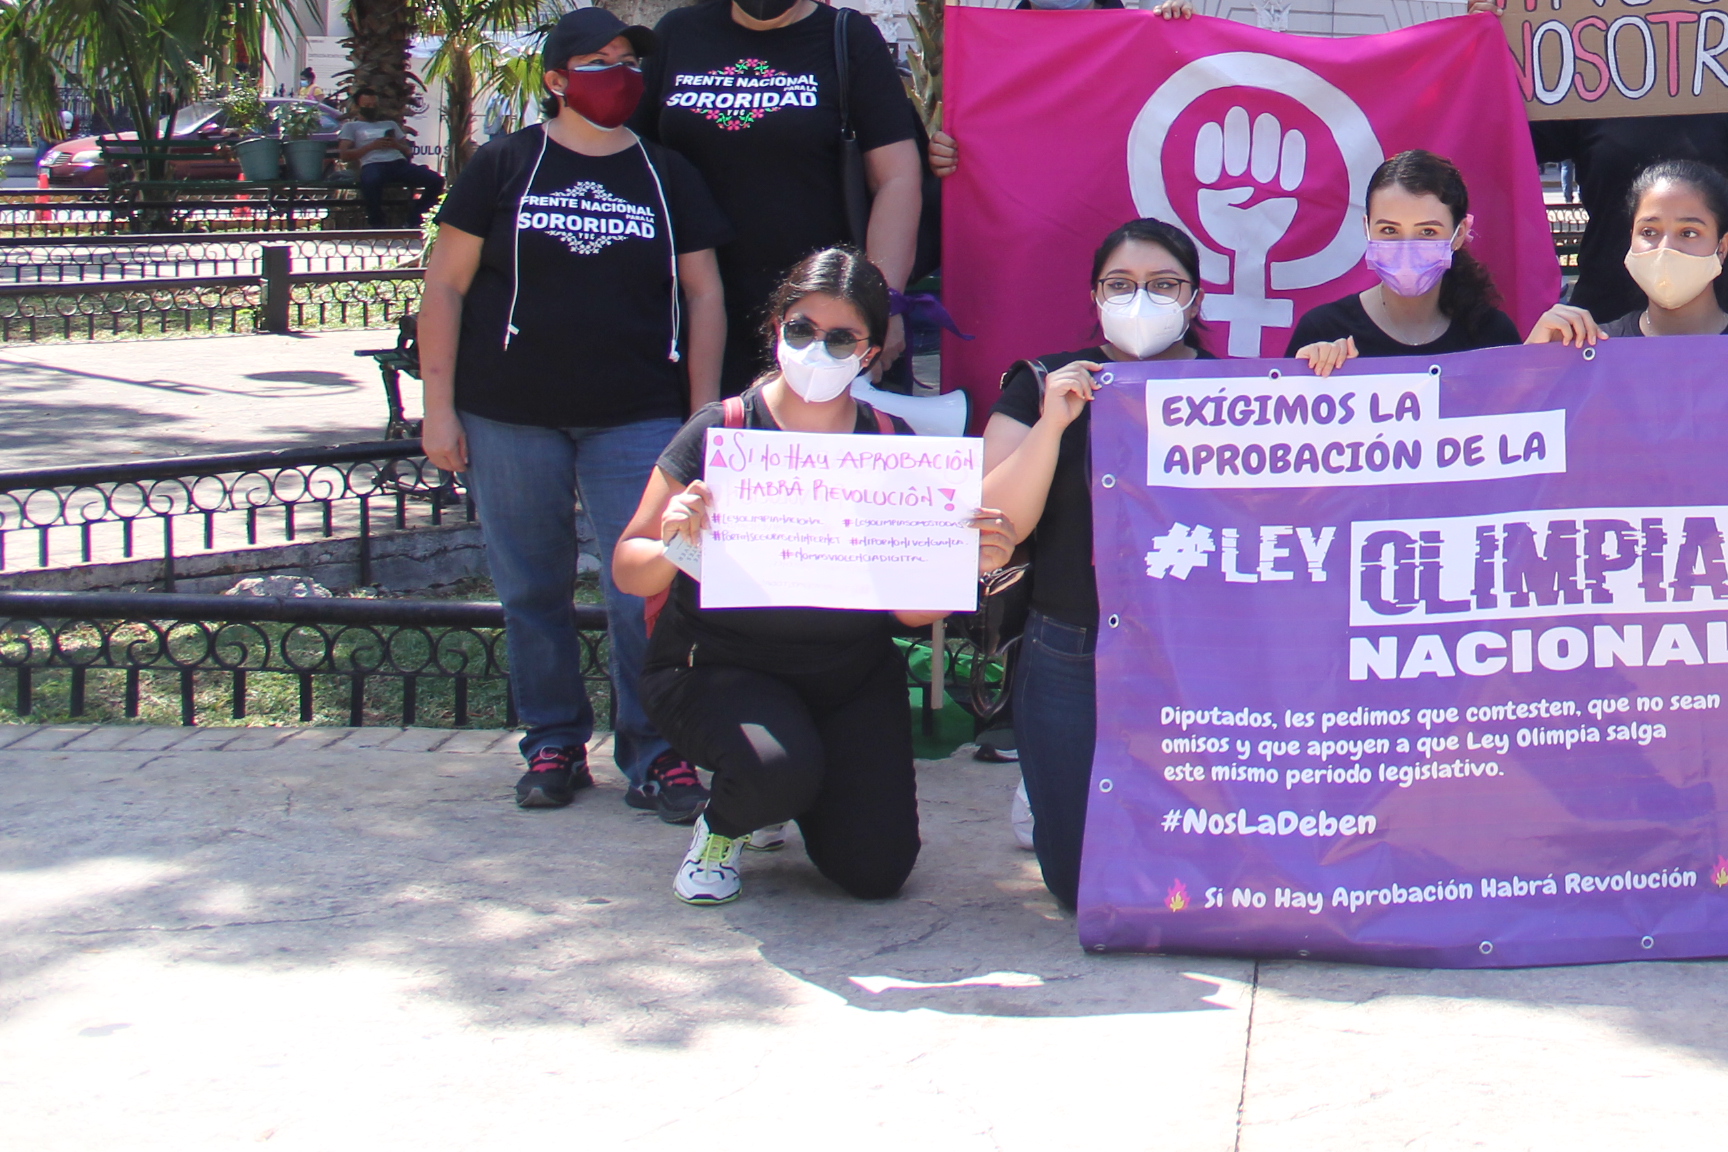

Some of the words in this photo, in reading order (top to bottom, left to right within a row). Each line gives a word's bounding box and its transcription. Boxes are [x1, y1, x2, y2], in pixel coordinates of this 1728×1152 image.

[675, 74, 735, 87] FRENTE
[736, 74, 818, 88] NACIONAL
[783, 84, 805, 92] PARA
[806, 85, 817, 93] LA
[666, 91, 818, 108] SORORIDAD
[520, 195, 579, 209] FRENTE
[581, 199, 656, 217] NACIONAL
[626, 213, 645, 222] PARA
[518, 212, 656, 239] SORORIDAD
[1370, 391, 1422, 423] LA
[1163, 433, 1422, 476] APROBACIÓN
[1436, 434, 1485, 469] DE
[1499, 431, 1547, 465] LA
[1145, 521, 1336, 583] #LEY
[1160, 705, 1279, 732] Diputados,
[1284, 709, 1316, 728] les
[1321, 705, 1411, 734] pedimos
[1416, 707, 1459, 731] que
[1465, 698, 1582, 723] contesten,
[1587, 695, 1630, 721] que
[1636, 695, 1664, 712] no
[1669, 693, 1721, 710] sean
[1161, 734, 1230, 754] omisos
[1236, 739, 1251, 760] y
[1257, 739, 1301, 762] que
[1307, 737, 1390, 762] apoyen
[1396, 737, 1411, 754] a
[1416, 734, 1460, 759] que
[1467, 731, 1510, 755] Ley
[1516, 723, 1601, 750] Olimpia
[1606, 721, 1667, 746] salga
[1164, 762, 1206, 782] este
[1211, 762, 1279, 784] mismo
[1286, 763, 1372, 790] periodo
[1378, 759, 1505, 788] legislativo.
[1160, 808, 1377, 837] #NosLaDeben
[1231, 887, 1267, 908] No
[1274, 887, 1324, 915] Hay
[1331, 878, 1474, 913] Aprobación
[1480, 873, 1558, 899] Habrá
[1564, 866, 1698, 895] Revolución
